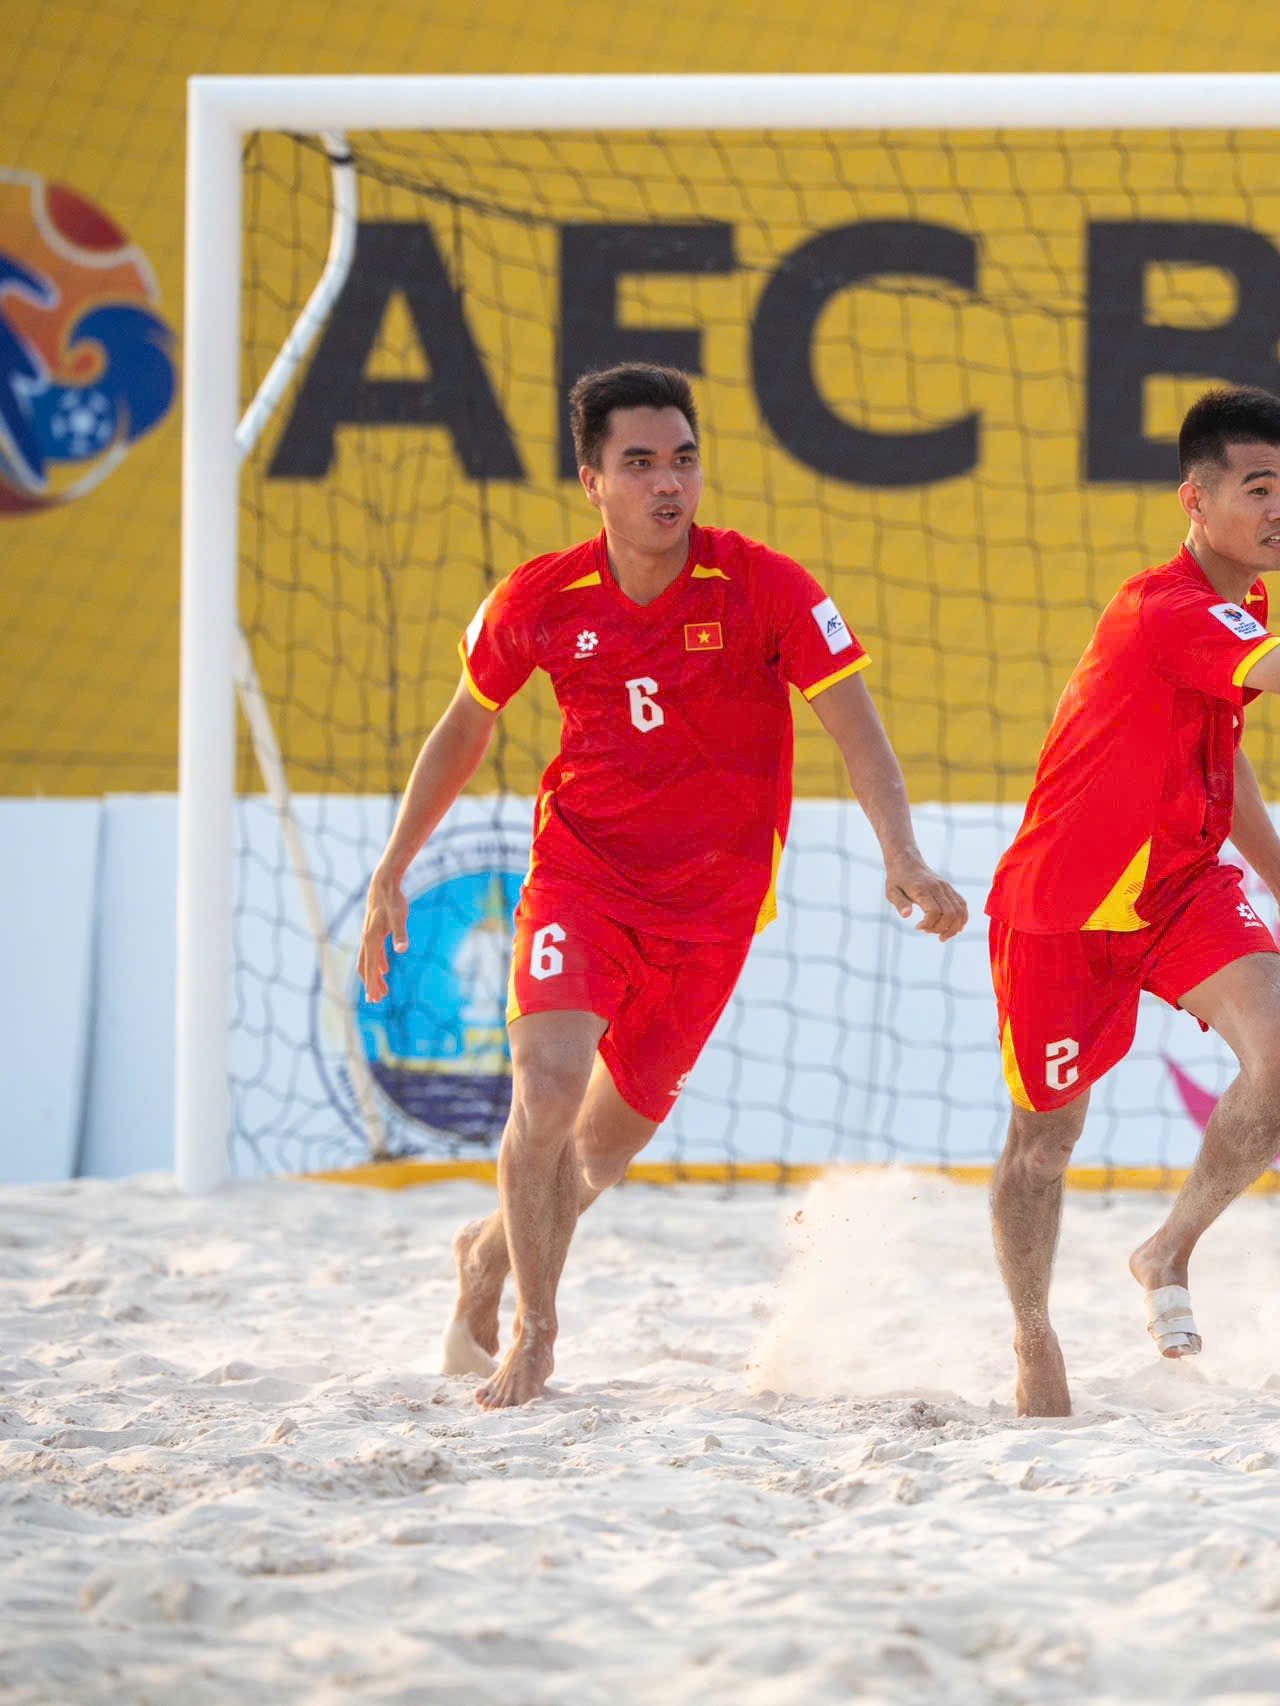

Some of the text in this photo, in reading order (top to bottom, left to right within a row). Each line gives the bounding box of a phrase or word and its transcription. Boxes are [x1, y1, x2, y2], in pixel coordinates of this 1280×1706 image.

[267, 220, 980, 487] AFC
[625, 676, 665, 733] 6
[530, 922, 567, 981] 6
[1045, 1037, 1080, 1091] 2
